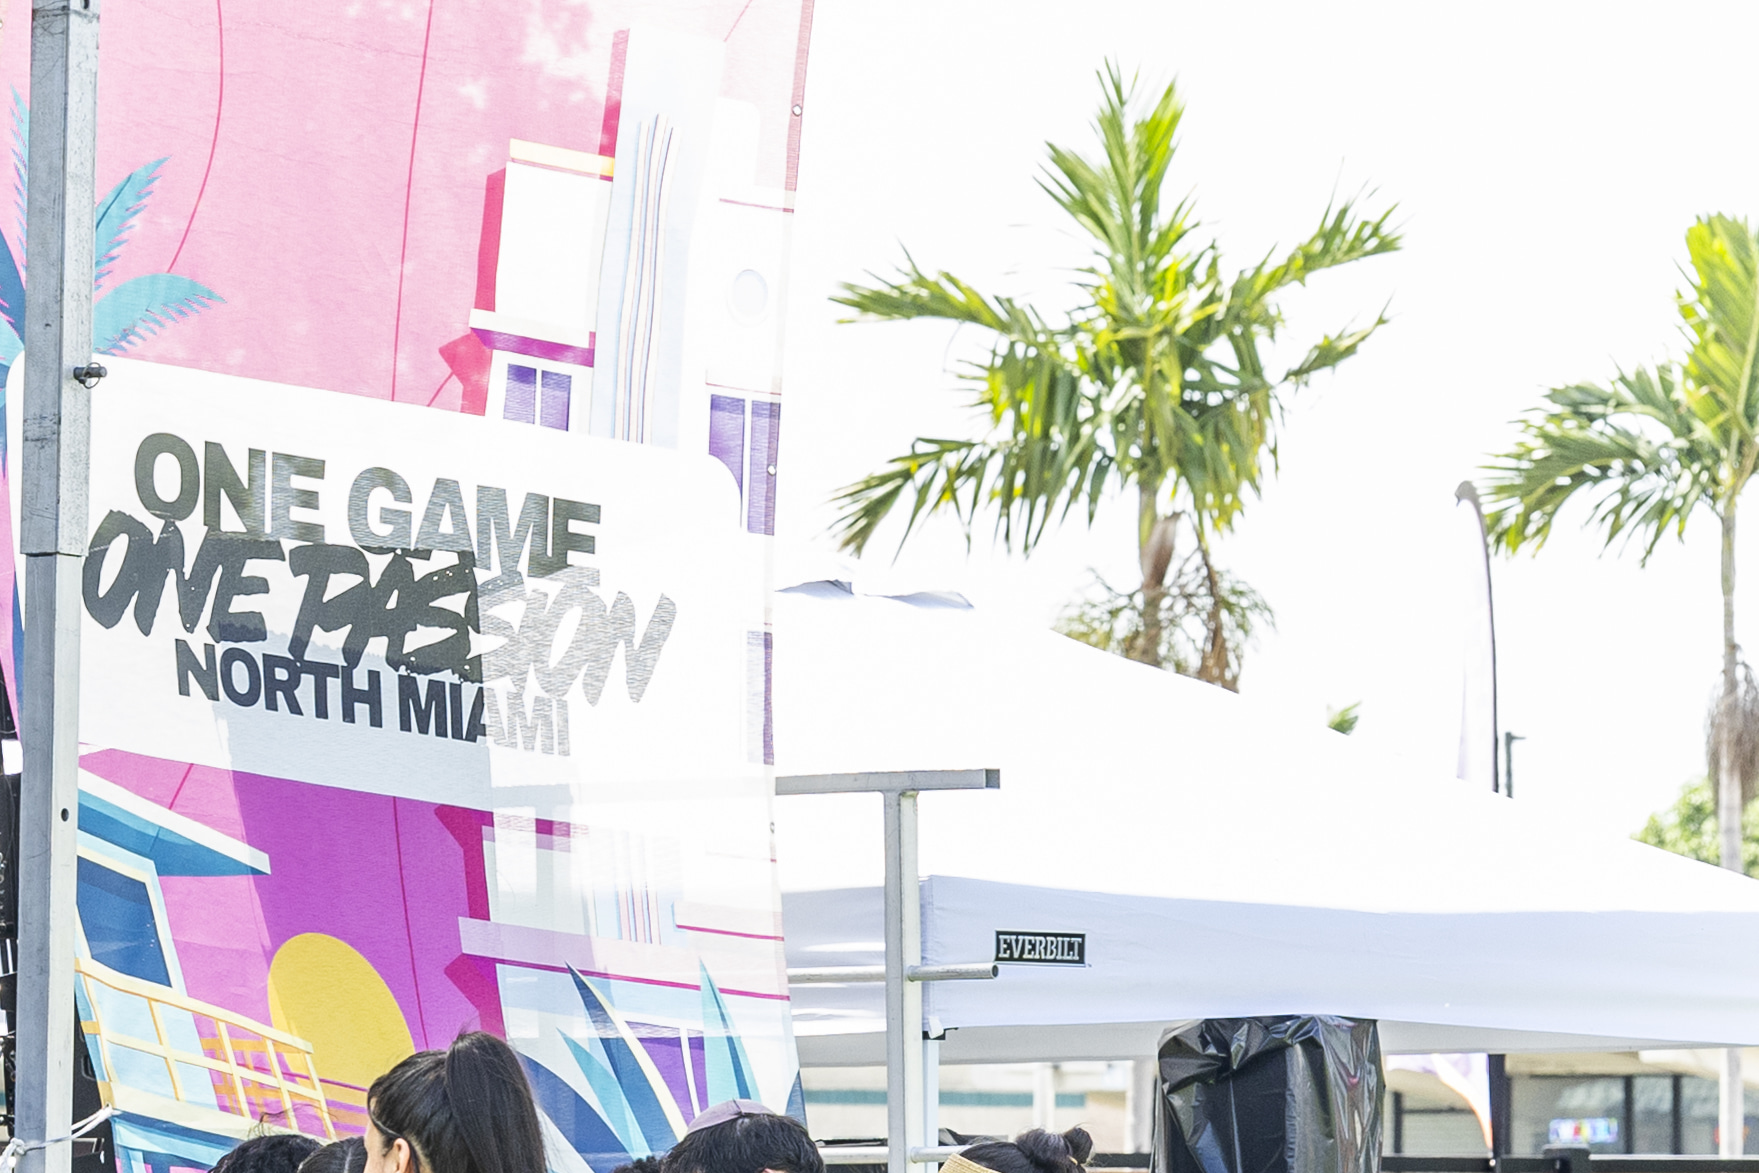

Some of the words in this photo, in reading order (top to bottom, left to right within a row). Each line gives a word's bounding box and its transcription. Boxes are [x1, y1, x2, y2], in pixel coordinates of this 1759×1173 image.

[135, 433, 326, 544] ONE
[347, 466, 601, 587] GAME
[82, 509, 286, 643] ONE
[289, 543, 677, 707] PASSION
[175, 638, 383, 728] NORTH
[397, 674, 571, 756] MIAMI
[998, 935, 1083, 960] EVERBILT
